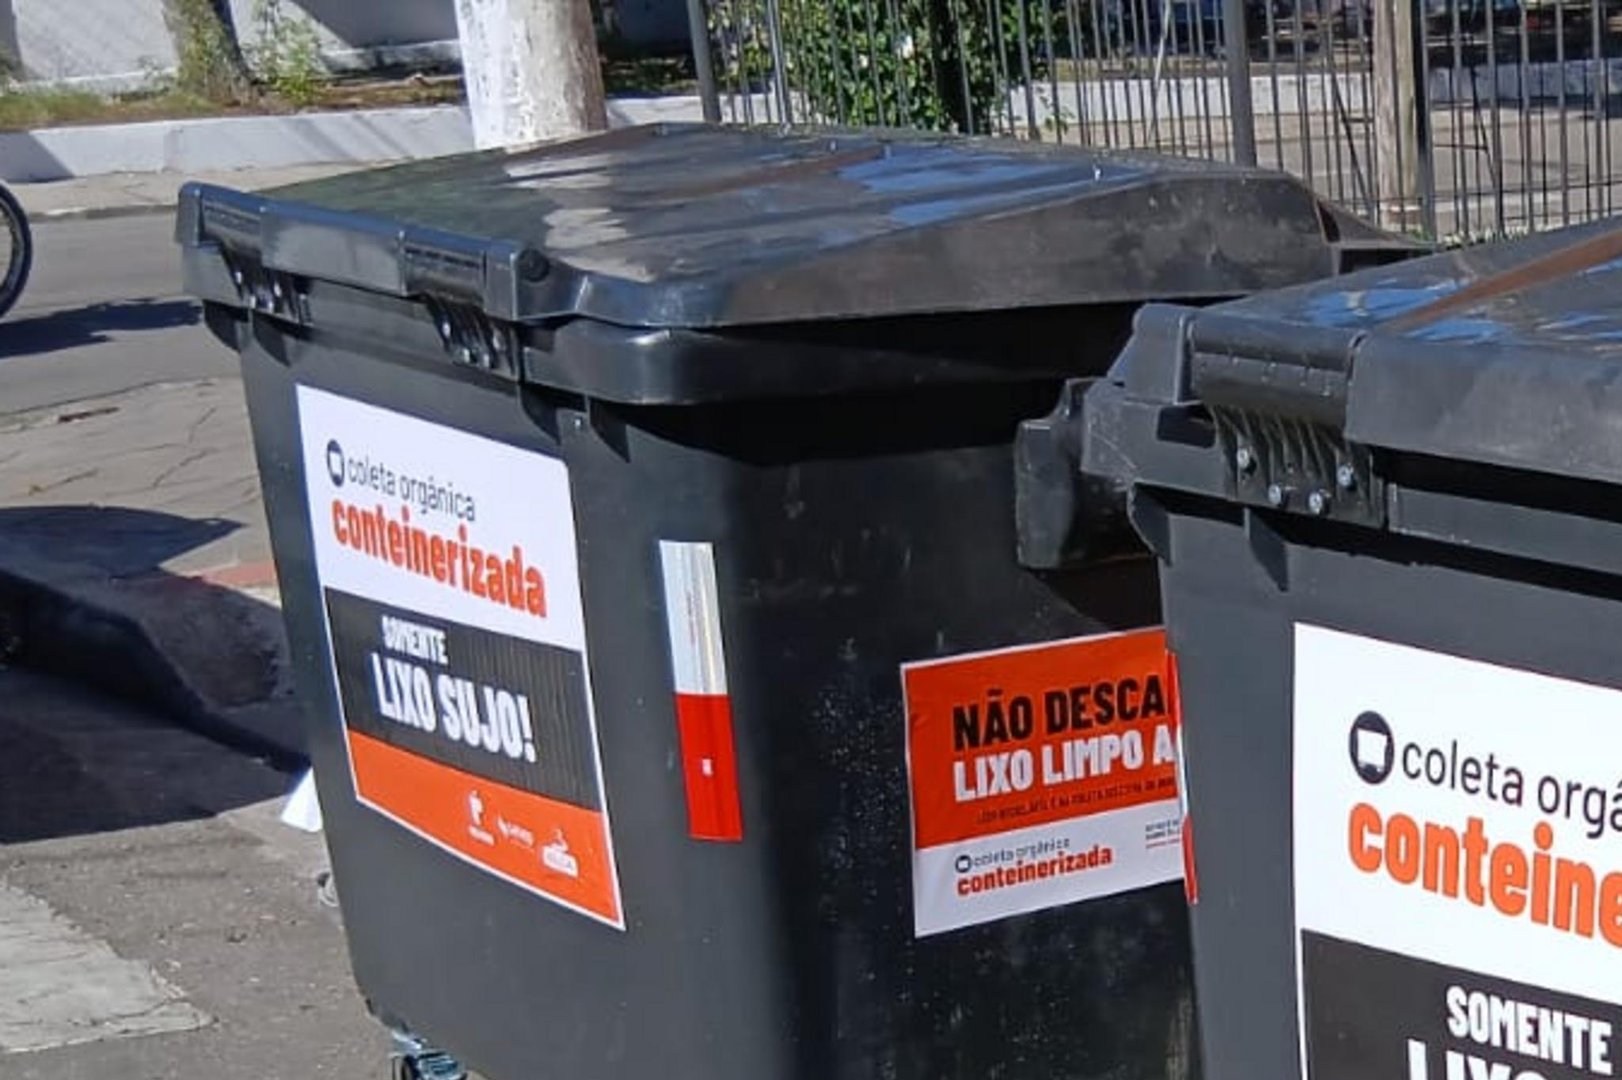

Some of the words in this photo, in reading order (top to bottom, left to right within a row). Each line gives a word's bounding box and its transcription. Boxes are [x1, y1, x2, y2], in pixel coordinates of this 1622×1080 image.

[349, 455, 396, 496] coleta
[400, 476, 475, 522] orgânica
[332, 499, 547, 618] conteinerizada
[382, 615, 448, 665] SOMENTE
[371, 652, 436, 733] LIXO
[438, 674, 536, 763] SUJO!
[953, 688, 1033, 751] NÃO
[1045, 674, 1166, 734] DESCA
[954, 749, 1033, 802] LIXO
[1042, 730, 1144, 785] LIMPO
[1401, 738, 1524, 806] coleta
[957, 844, 1112, 896] conteinerizada
[1447, 985, 1612, 1075] SOMENTE
